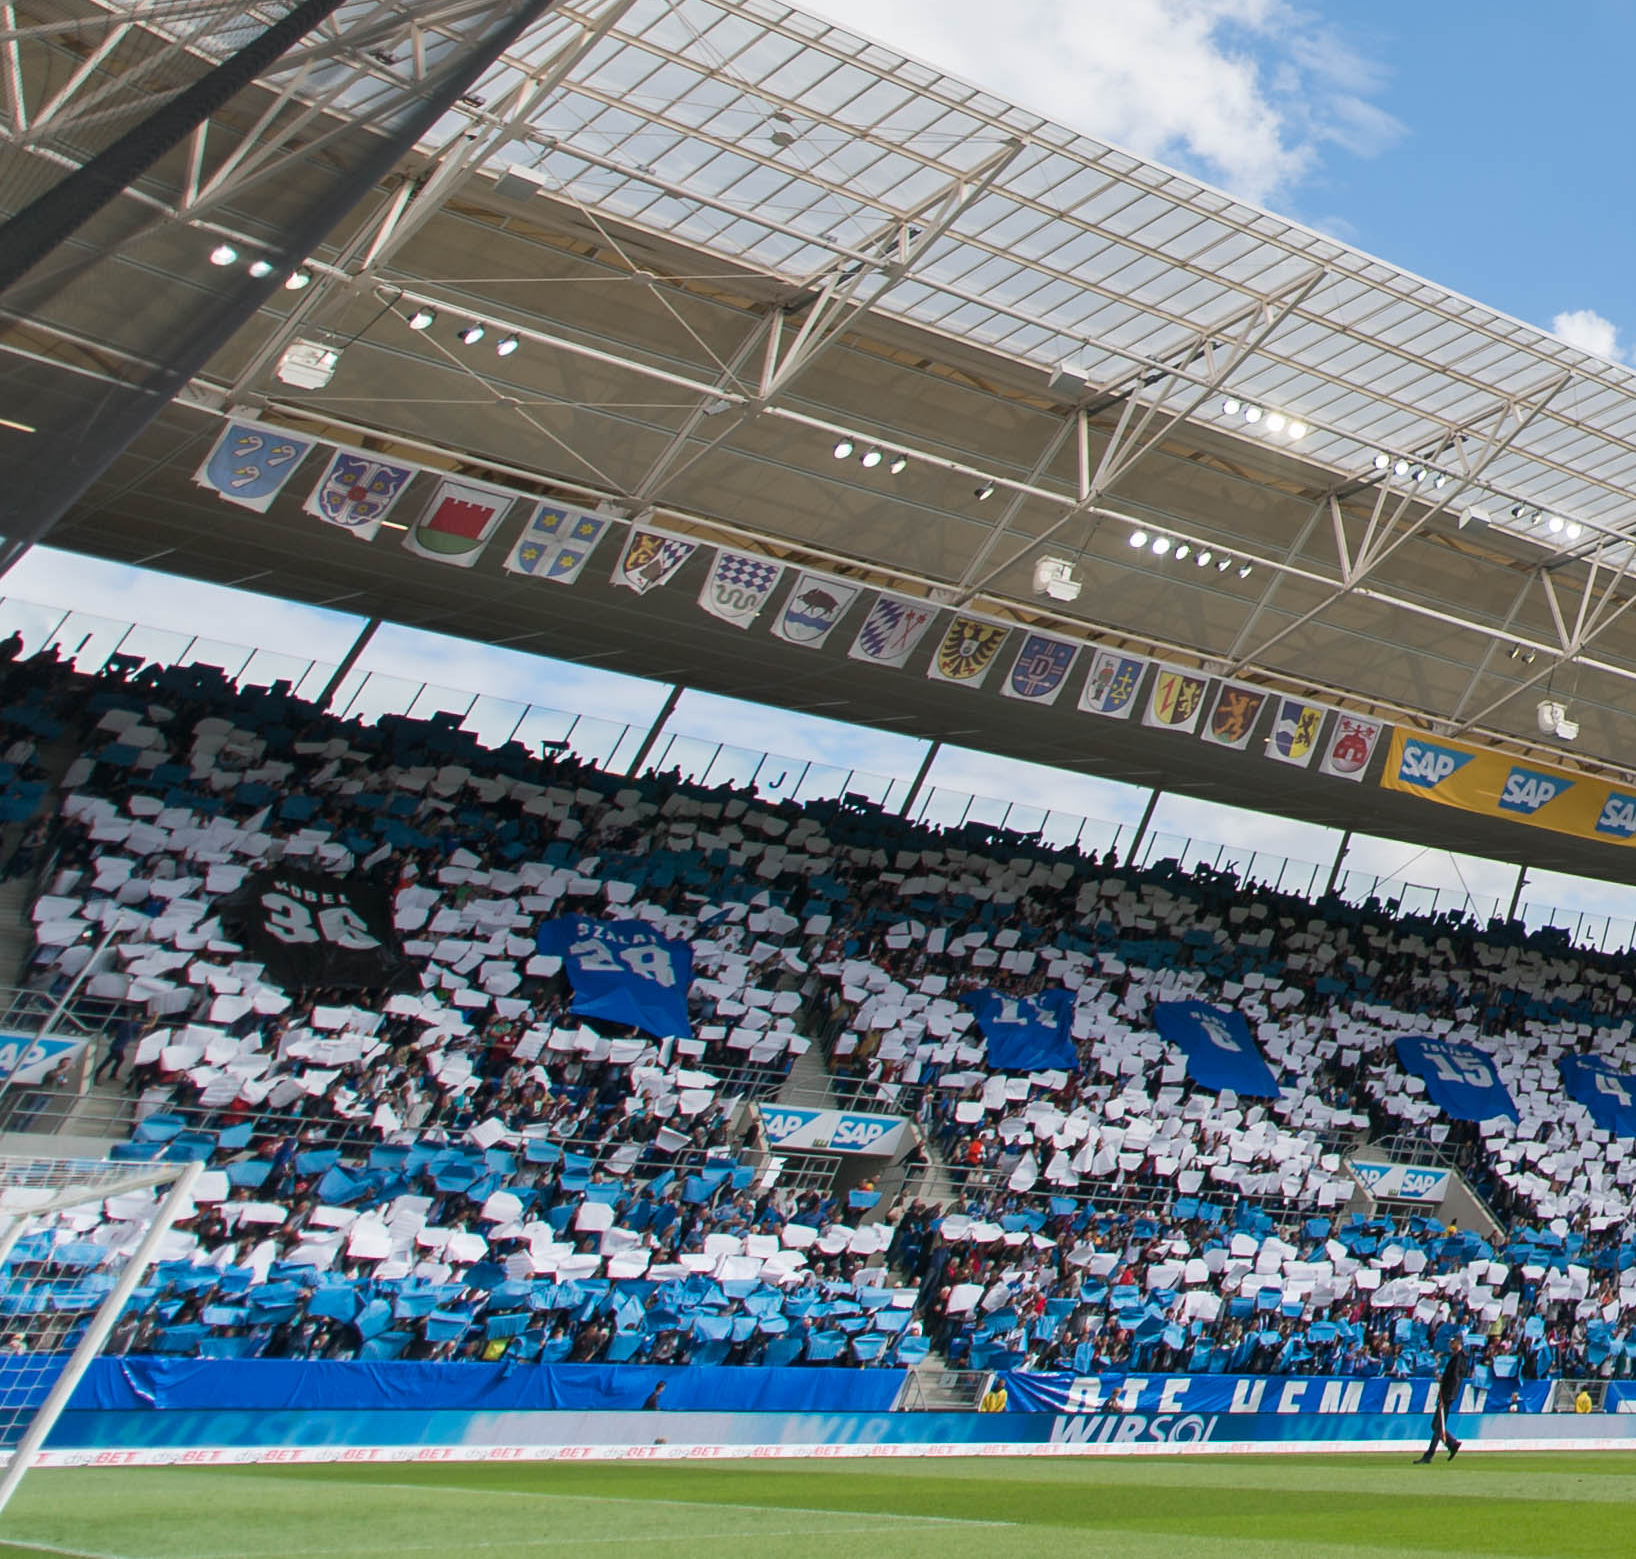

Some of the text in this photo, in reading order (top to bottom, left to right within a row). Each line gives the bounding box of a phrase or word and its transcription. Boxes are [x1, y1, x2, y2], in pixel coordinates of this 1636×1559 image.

[1402, 746, 1454, 782] SAP
[768, 771, 787, 789] J
[1502, 774, 1555, 808] SAP
[1225, 859, 1239, 873] K
[1586, 924, 1594, 940] L
[0, 1044, 45, 1070] AP
[1424, 1053, 1494, 1088] 15
[1595, 1073, 1632, 1106] 4
[834, 1119, 883, 1146] SAP
[1353, 1167, 1381, 1185] AP
[1401, 1172, 1436, 1194] SAP
